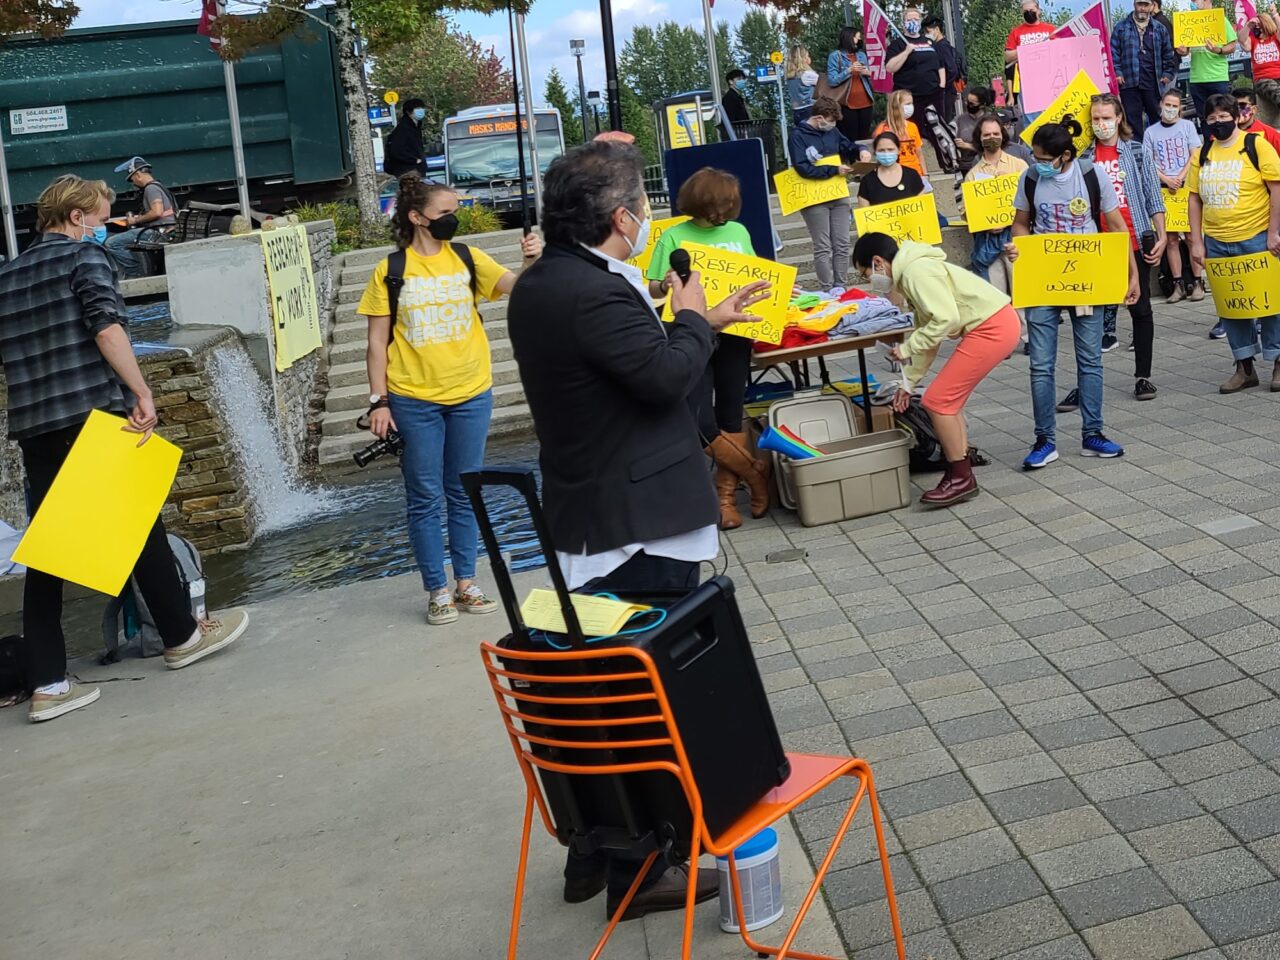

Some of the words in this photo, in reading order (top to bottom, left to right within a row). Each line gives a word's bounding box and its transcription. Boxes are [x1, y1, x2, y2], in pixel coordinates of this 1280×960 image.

[864, 201, 923, 223] RESEARCH
[1044, 239, 1101, 256] RESEARCH
[690, 250, 780, 284] RESEARCH
[1209, 257, 1268, 277] RESEARCH
[1231, 280, 1244, 292] IS
